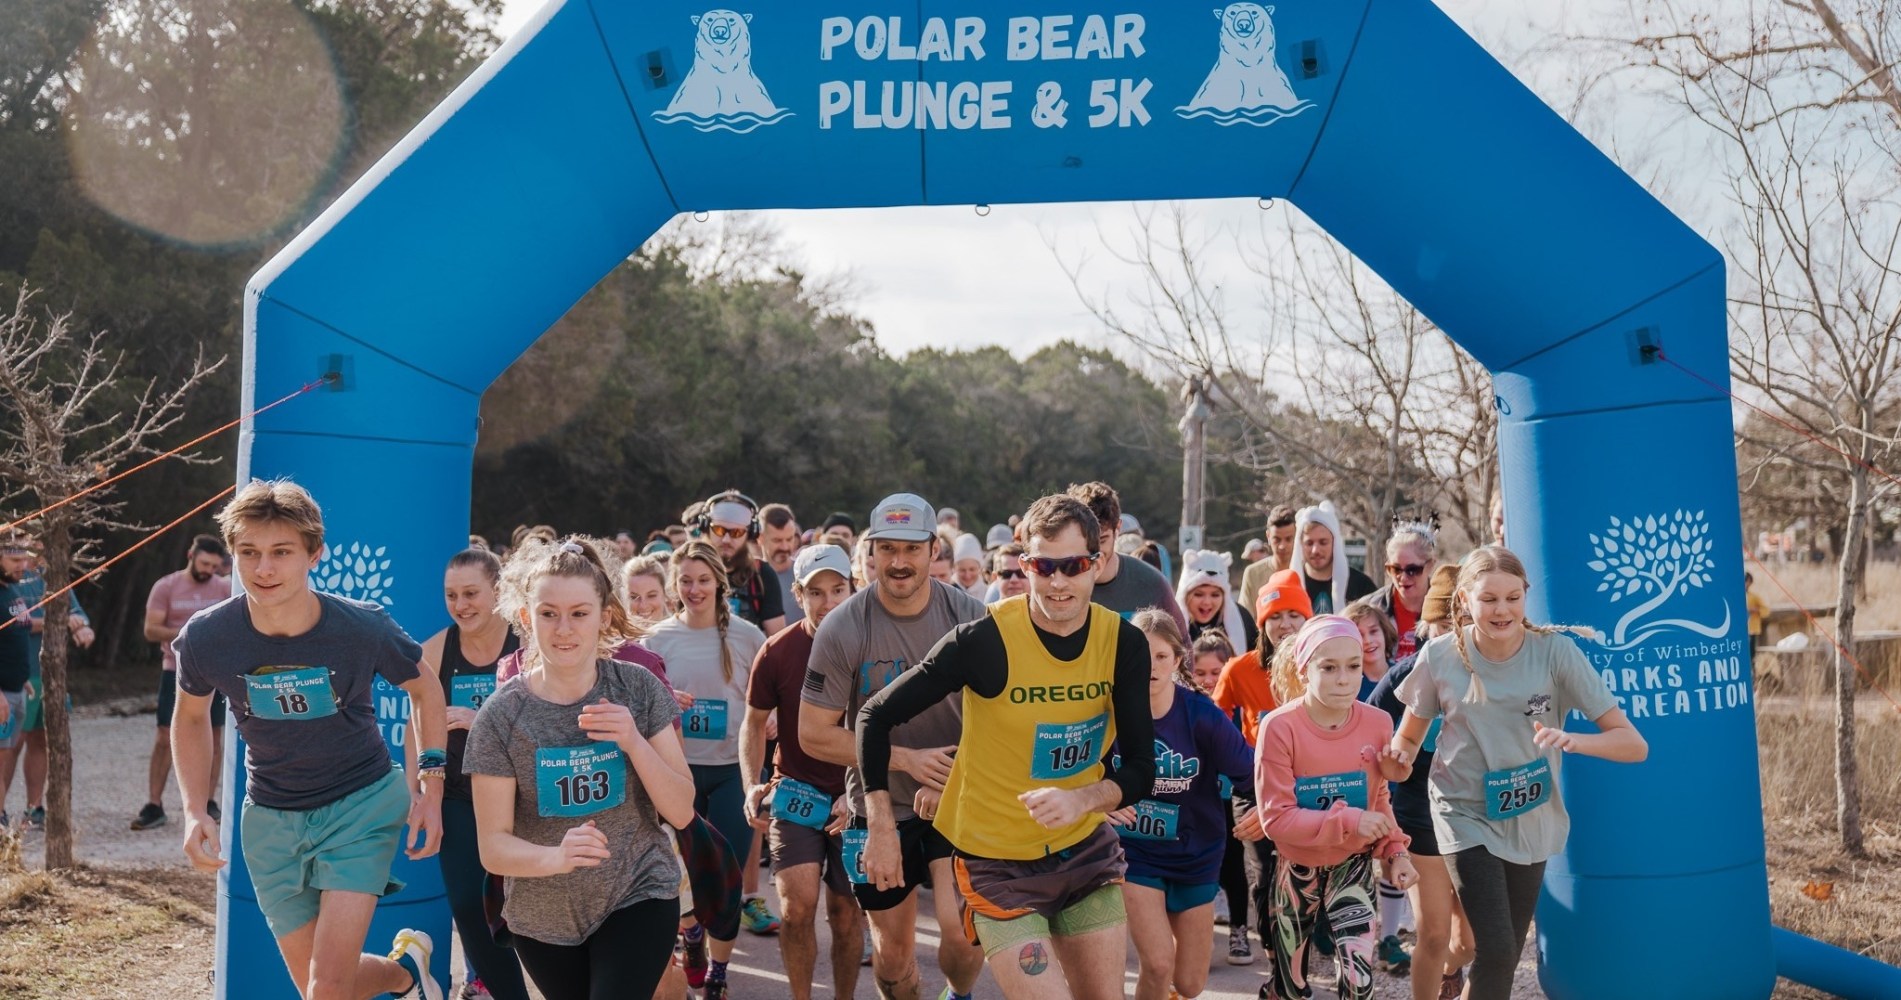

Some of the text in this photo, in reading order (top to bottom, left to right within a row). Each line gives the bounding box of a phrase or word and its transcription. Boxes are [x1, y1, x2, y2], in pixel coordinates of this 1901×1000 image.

[821, 14, 1146, 61] POLAR BEAR
[819, 77, 1153, 130] PLUNGE & 5K
[1586, 639, 1743, 667] ity of Wimberley
[295, 677, 325, 687] PLUNGE
[1601, 656, 1740, 692] ARKS AND
[273, 692, 310, 715] 18
[1010, 681, 1113, 704] OREGON
[689, 714, 710, 733] 81
[1064, 731, 1082, 739] BEAR
[540, 759, 567, 767] POLAR
[569, 757, 590, 766] BEAR
[592, 750, 619, 763] PLUNGE
[1049, 738, 1093, 772] 194
[581, 764, 592, 772] 5K
[1510, 774, 1526, 783] BEAR
[1527, 765, 1548, 779] PLUNGE
[554, 769, 610, 807] 163
[1497, 781, 1543, 813] 259
[786, 797, 814, 818] 88
